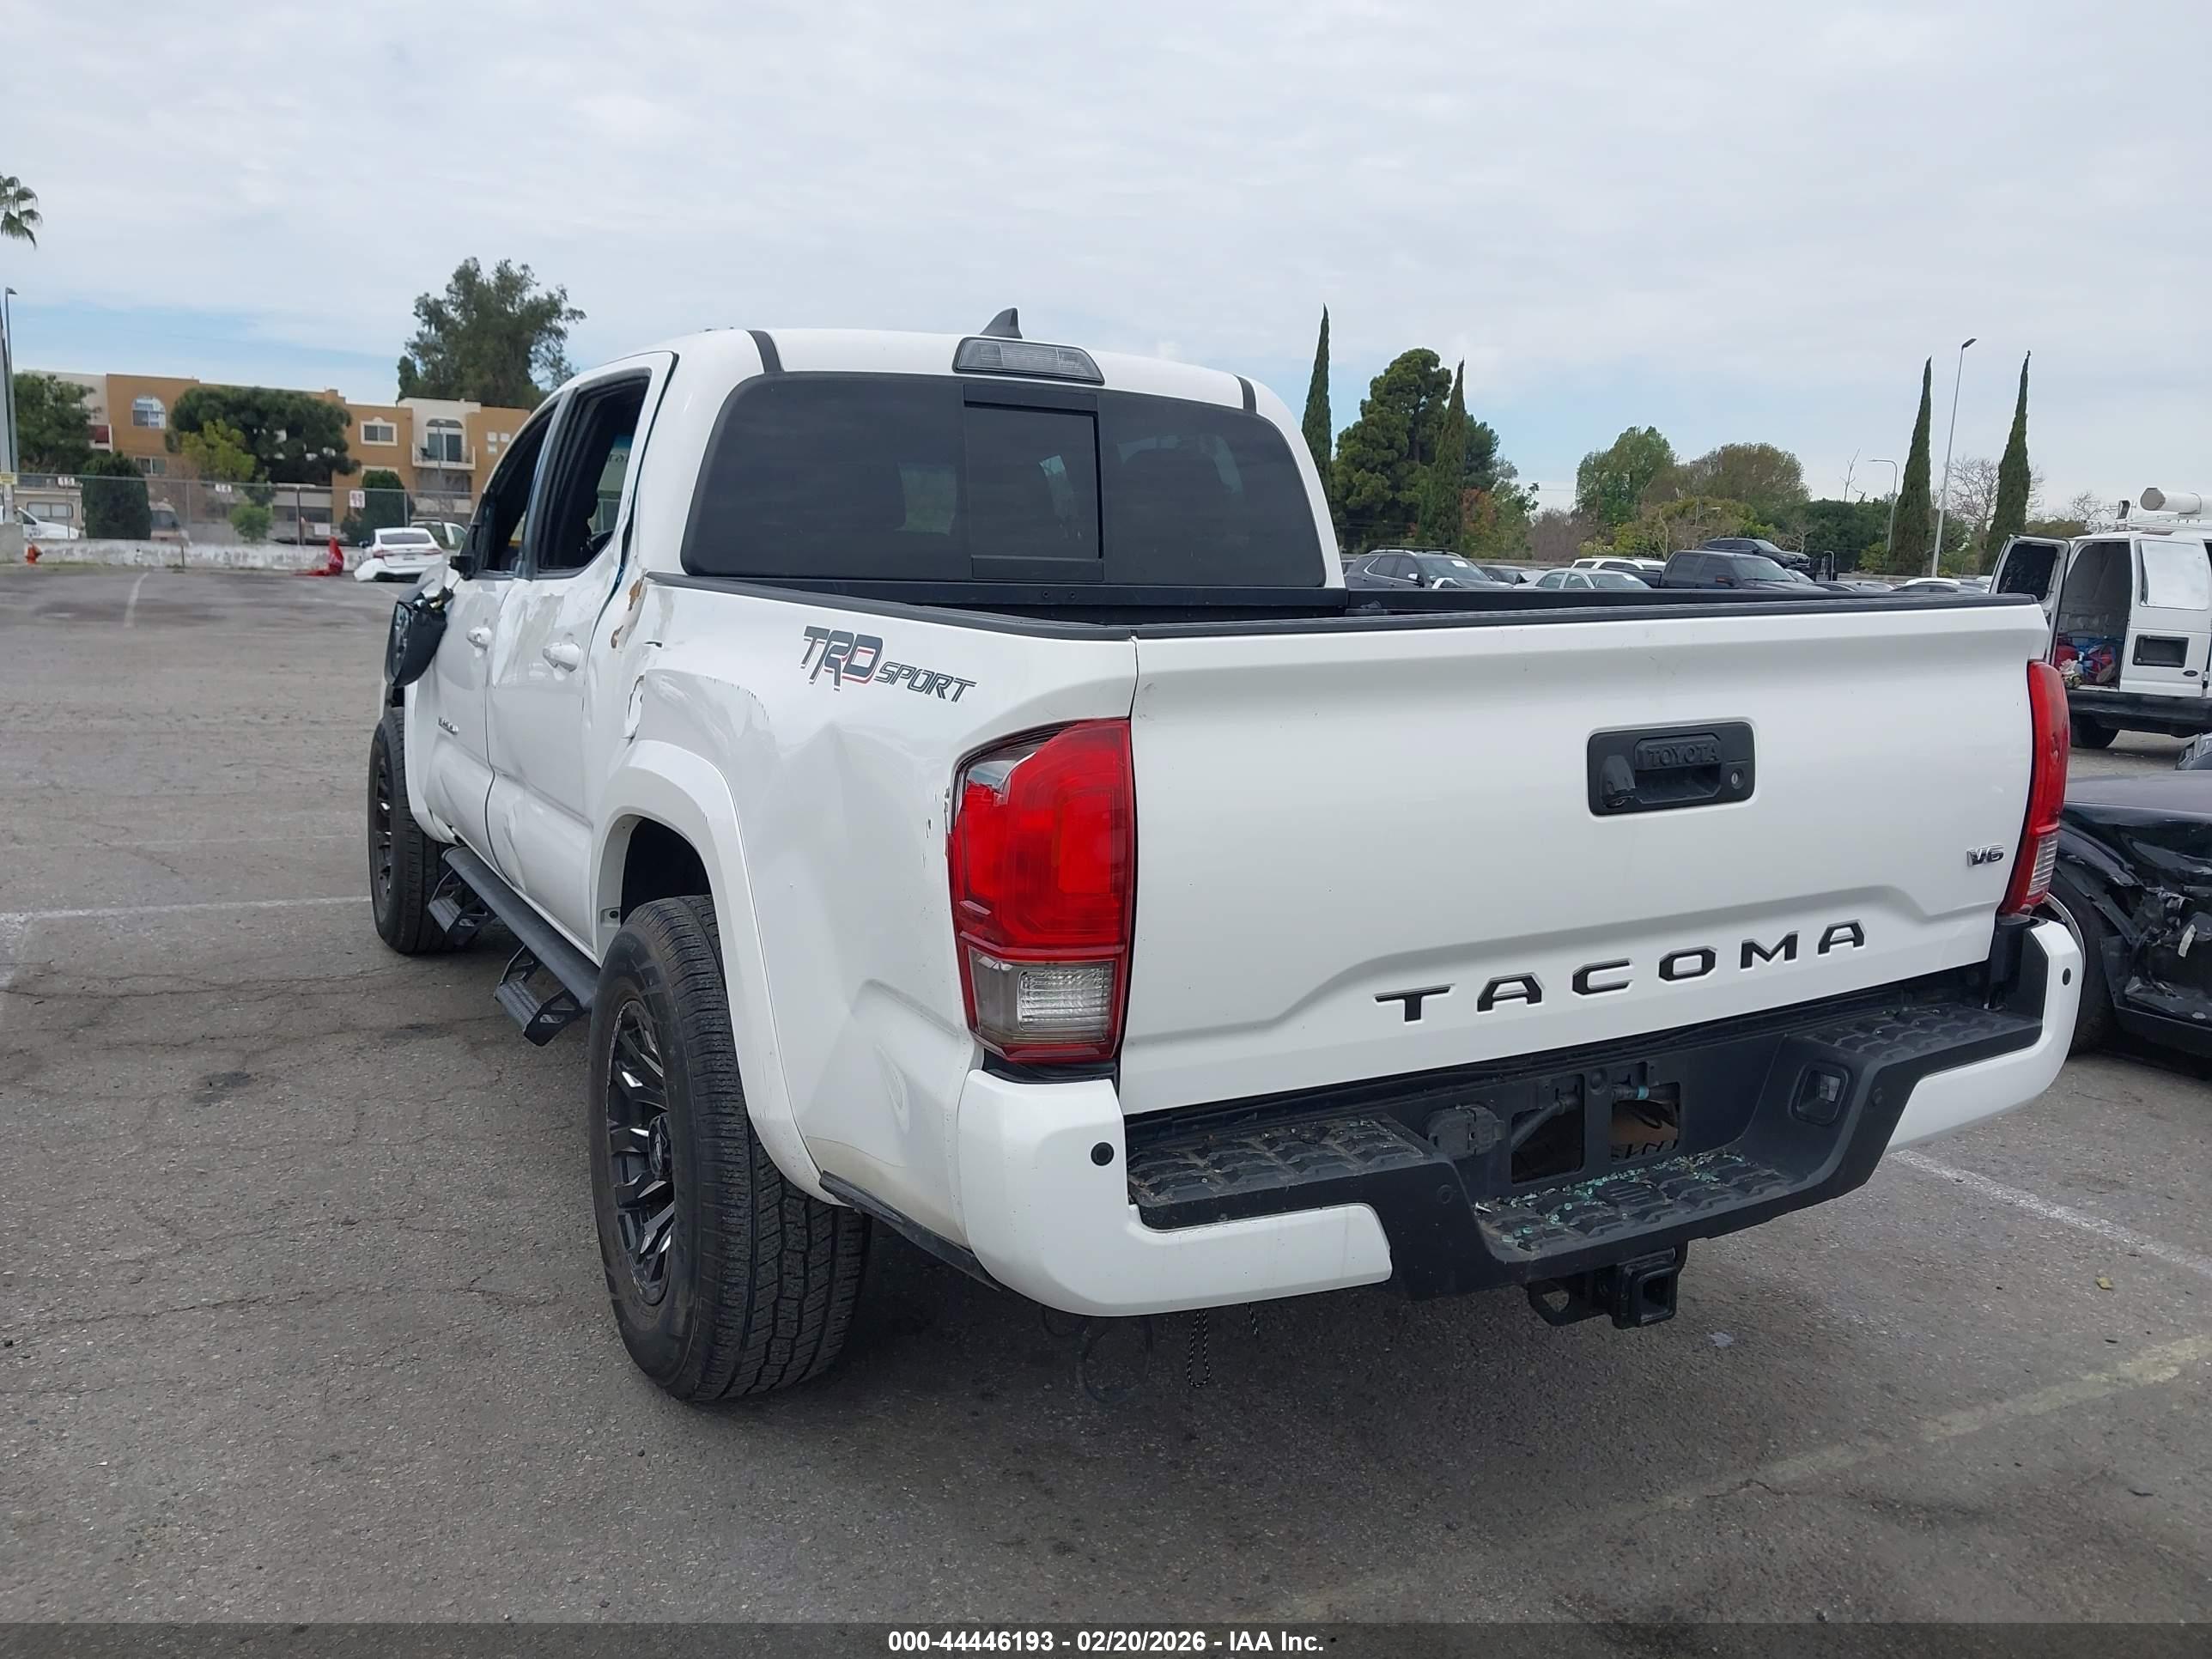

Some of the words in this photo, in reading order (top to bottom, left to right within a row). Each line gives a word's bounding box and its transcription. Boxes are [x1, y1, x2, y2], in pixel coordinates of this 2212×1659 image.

[800, 625, 884, 691] TRD
[873, 660, 977, 702] SPORT
[1648, 743, 1720, 767] TOYOTA
[1966, 843, 2004, 866] V6
[1373, 920, 1866, 1023] TACOMA
